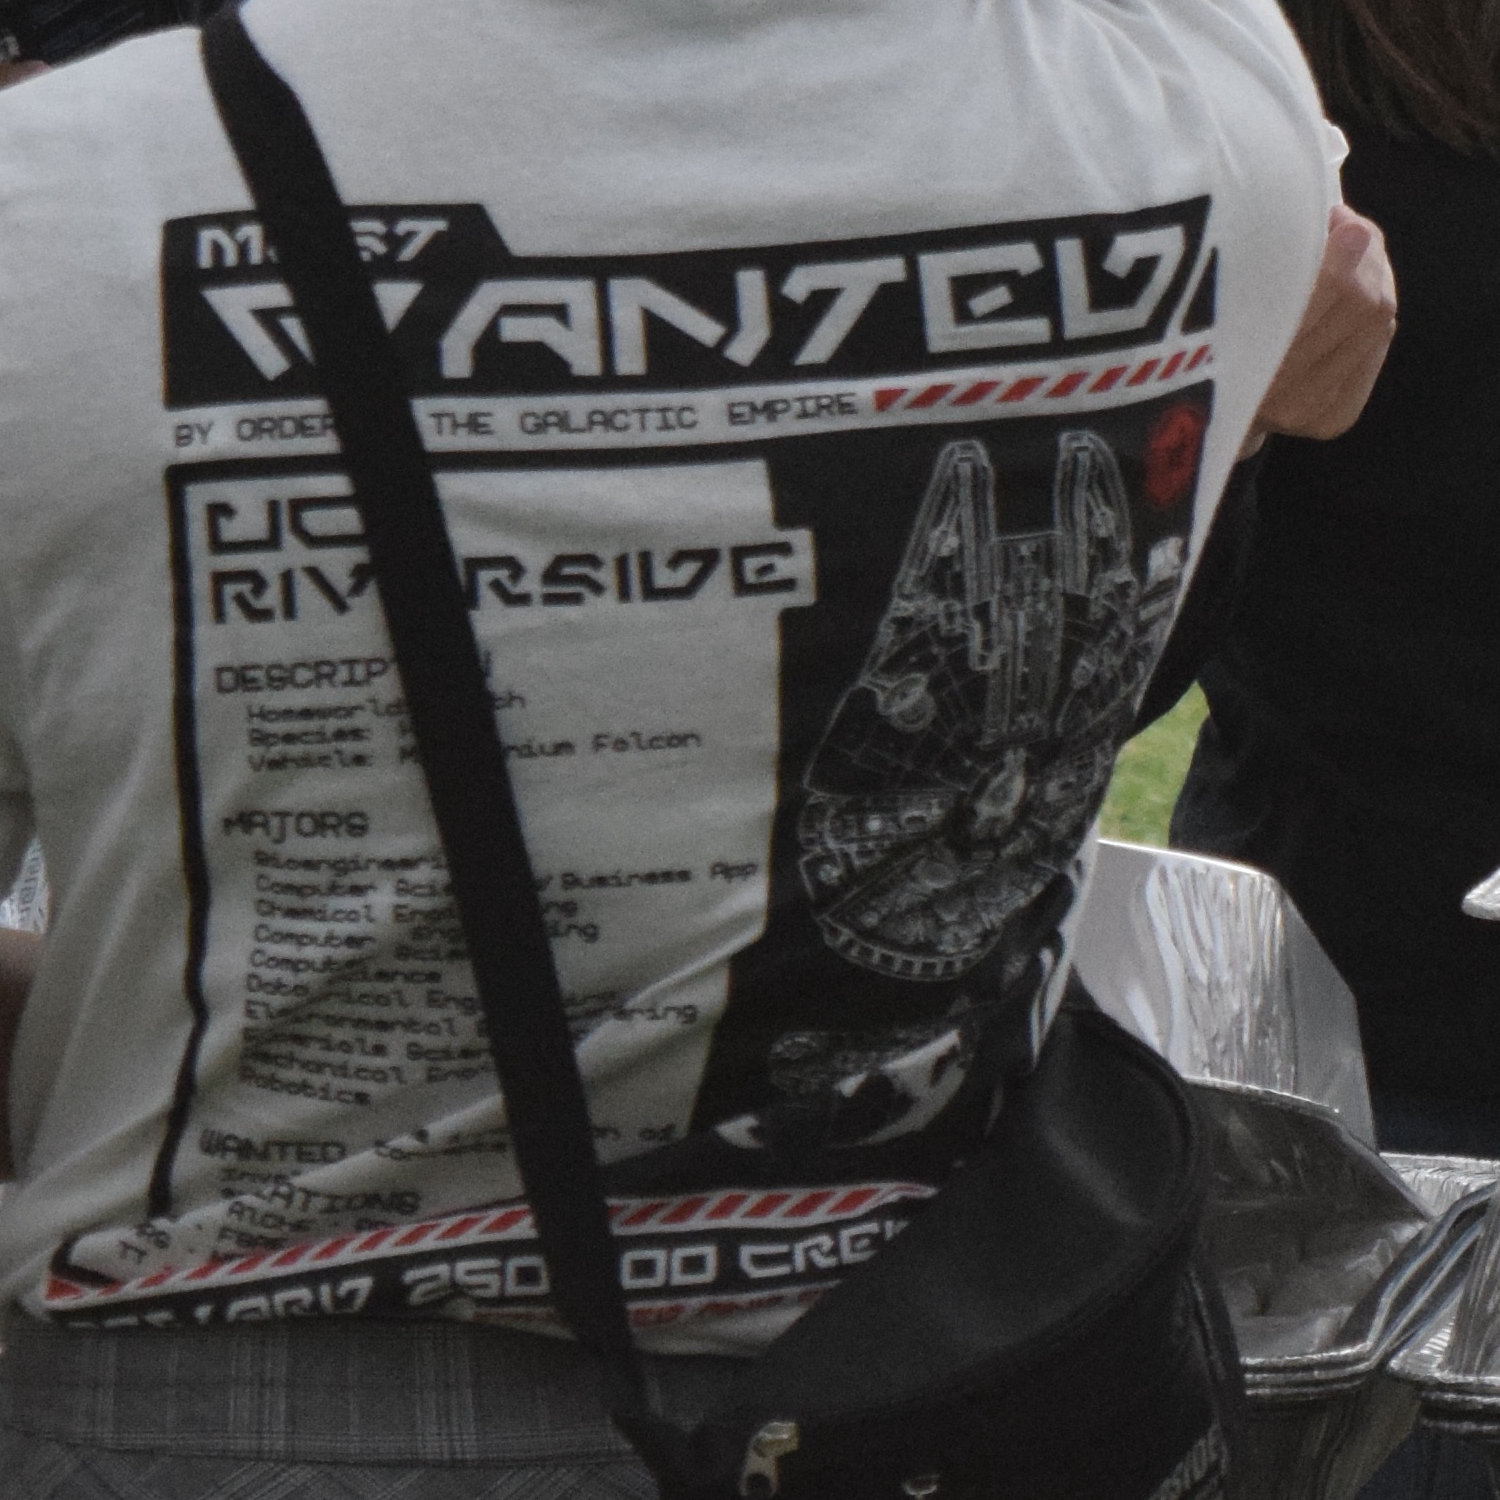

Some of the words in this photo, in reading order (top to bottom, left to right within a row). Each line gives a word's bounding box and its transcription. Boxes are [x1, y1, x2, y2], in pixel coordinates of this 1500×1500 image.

[197, 217, 453, 272] MST
[174, 425, 212, 448] BY
[430, 411, 495, 437] THE
[519, 405, 699, 436] GALACTIC
[726, 392, 859, 427] EMPIRE
[210, 540, 798, 624] RIVRSIDE
